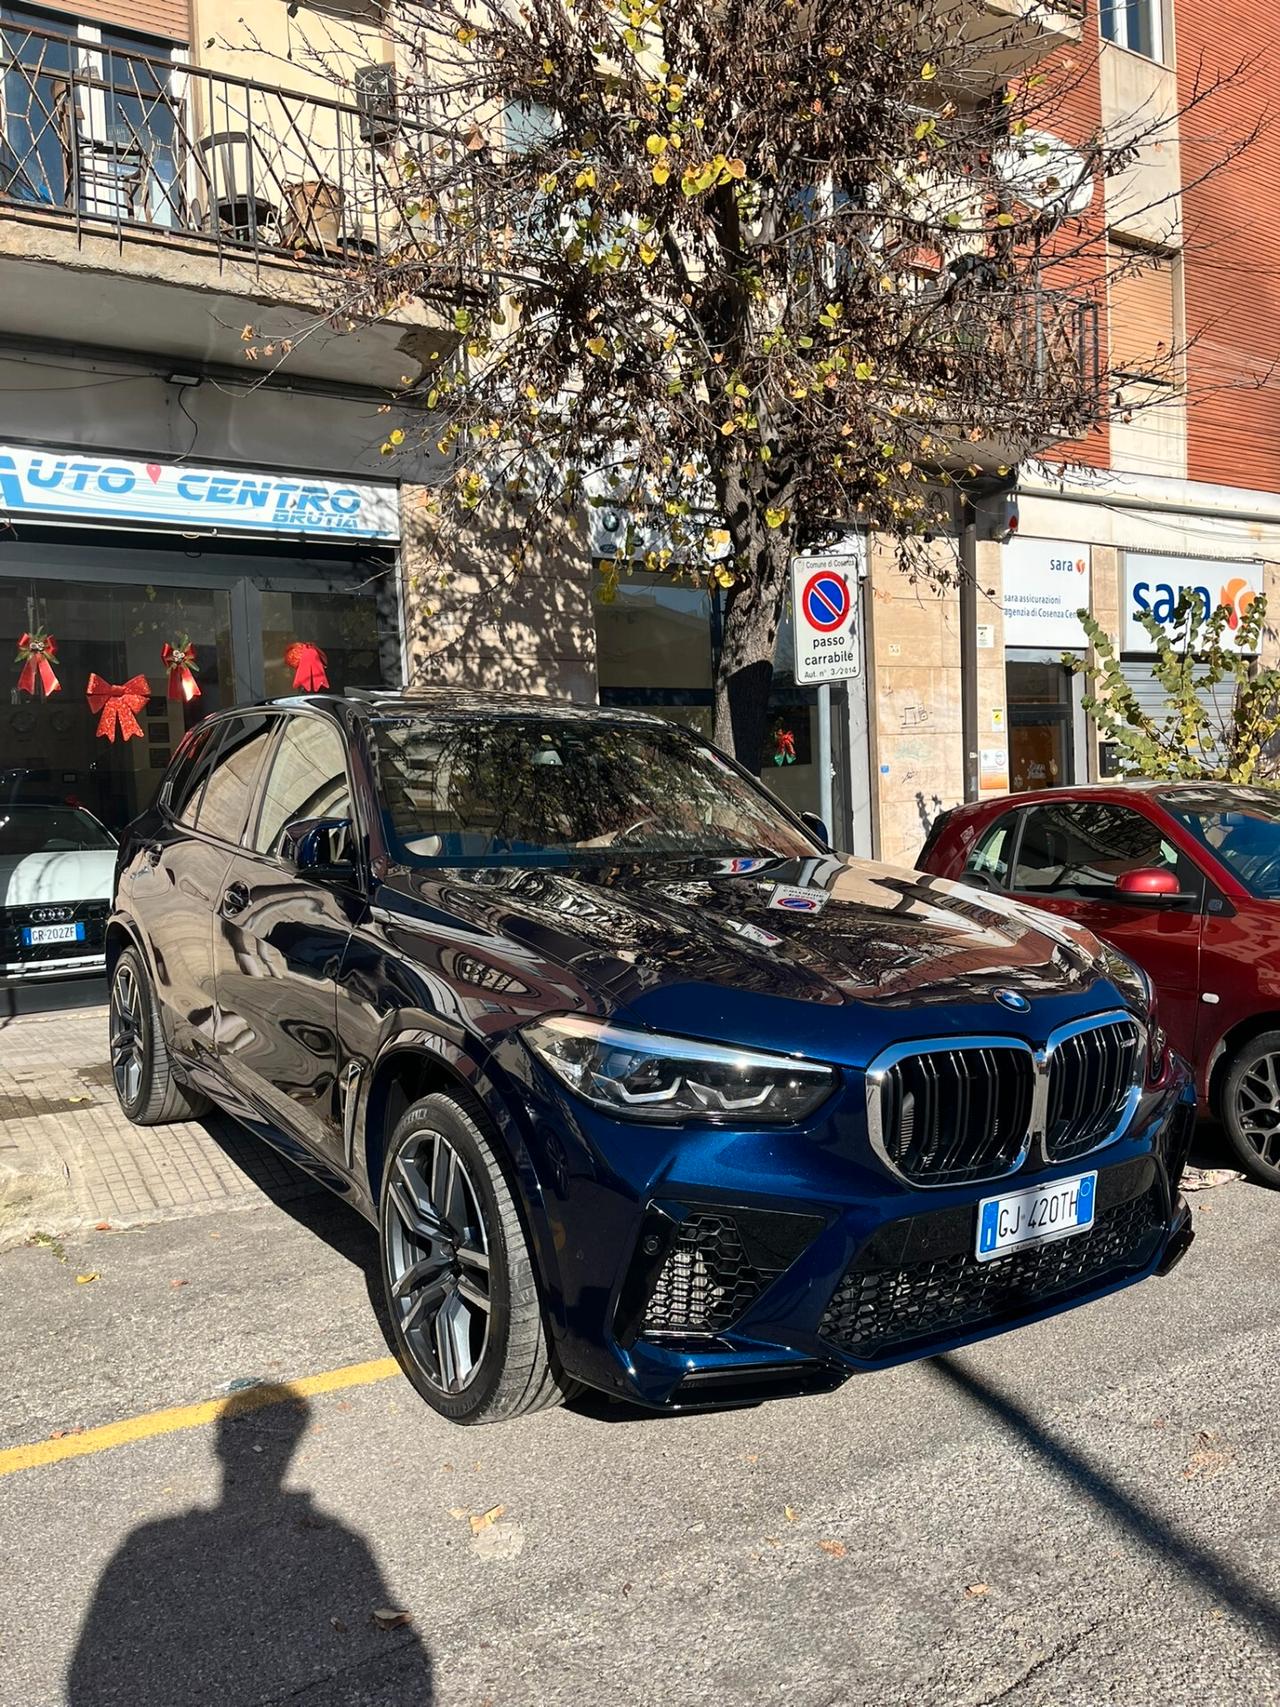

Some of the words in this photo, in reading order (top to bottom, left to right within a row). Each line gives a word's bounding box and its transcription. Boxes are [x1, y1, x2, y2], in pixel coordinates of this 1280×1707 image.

[177, 475, 361, 514] CENTRO
[272, 509, 359, 529] BRUTIA
[806, 561, 826, 569] Comune
[1050, 559, 1073, 572] sara
[1004, 594, 1019, 603] sara
[1019, 594, 1062, 605] assicurazioni
[1004, 608, 1030, 618] agenzia
[1031, 608, 1037, 617] di
[1038, 608, 1064, 619] Cosenza
[813, 637, 845, 650] passo
[805, 651, 854, 665] carrabile
